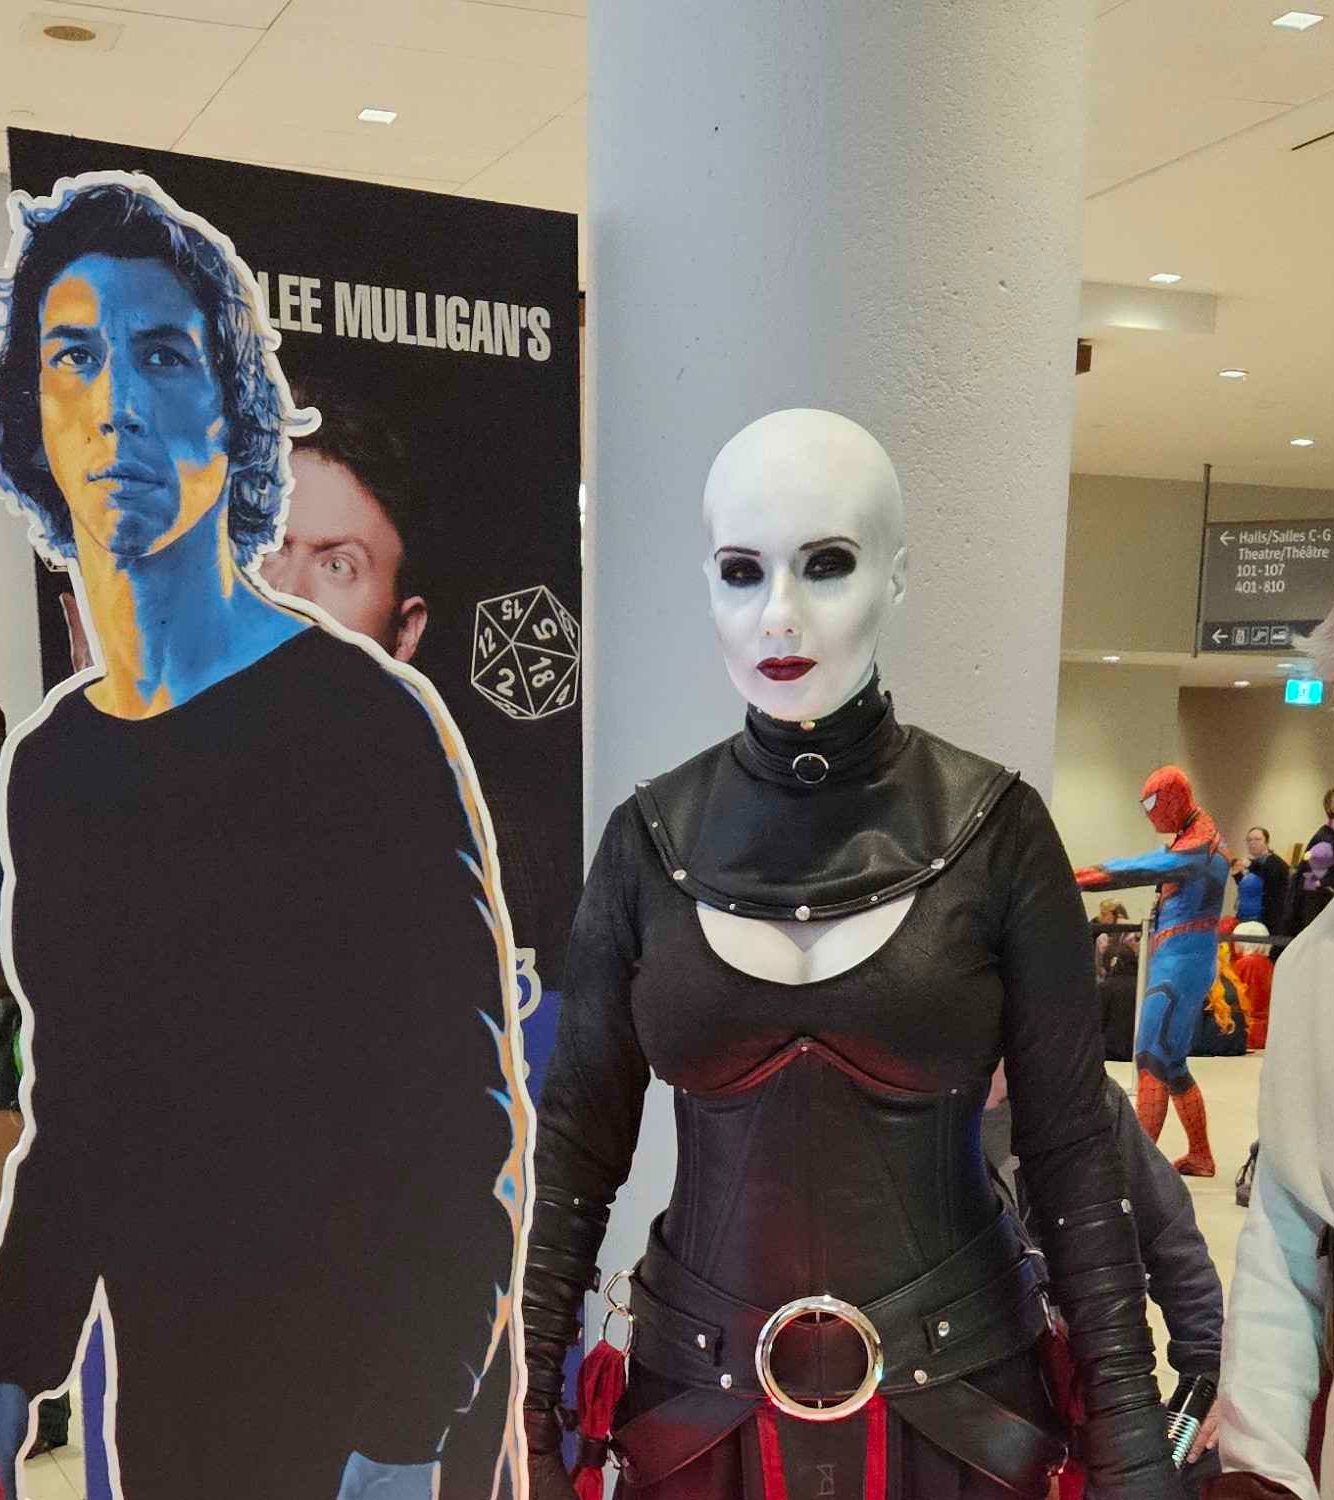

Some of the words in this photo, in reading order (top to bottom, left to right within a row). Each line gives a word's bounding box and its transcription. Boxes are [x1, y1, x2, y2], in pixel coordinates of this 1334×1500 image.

[256, 271, 322, 334] LEE
[334, 281, 551, 363] MULLIGAN'S
[1238, 529, 1306, 545] Halls/Salles
[1238, 545, 1330, 561] Theatre/Théâtre
[1236, 563, 1286, 578] 101-107
[1234, 580, 1285, 594] 401-810
[501, 599, 524, 621] 15
[532, 618, 558, 641] 5
[478, 627, 496, 659] 12
[495, 667, 516, 697] 2
[528, 656, 556, 688] 18
